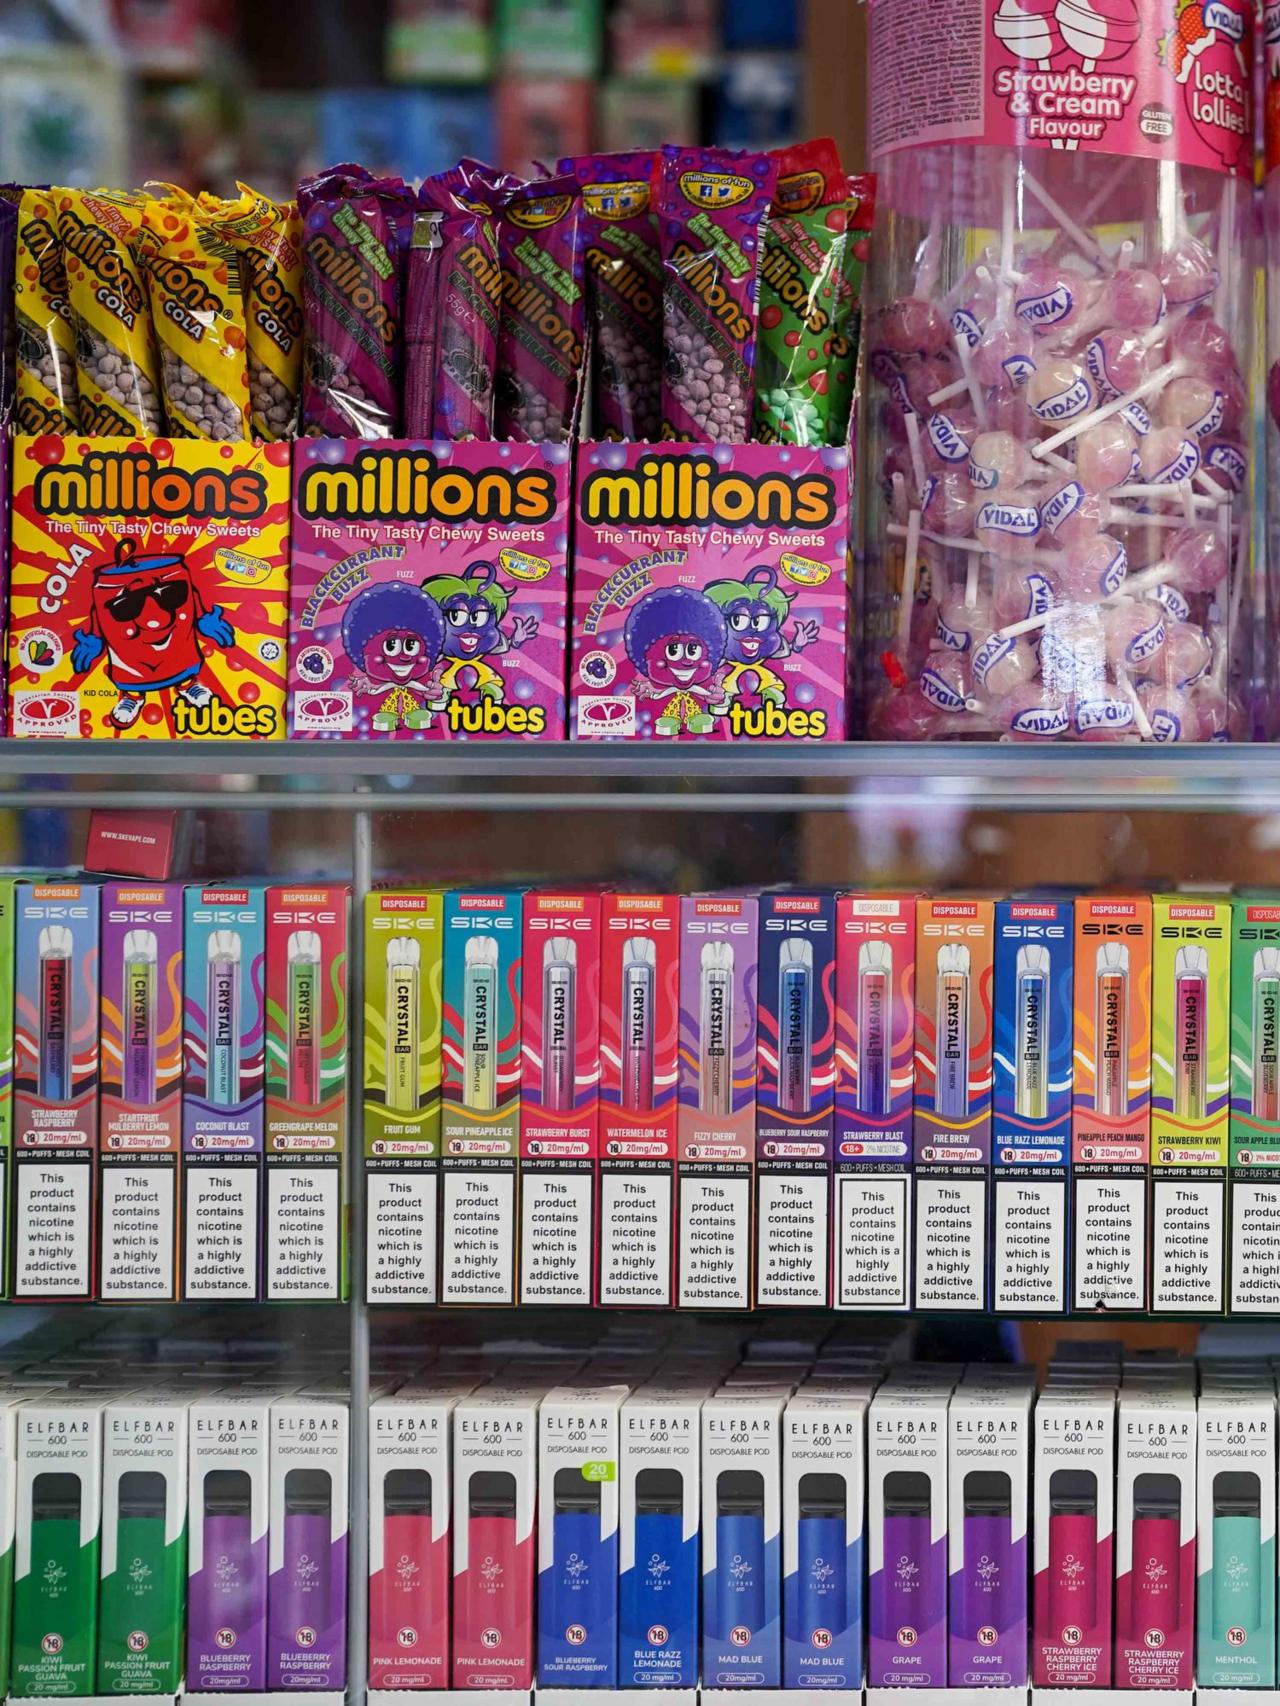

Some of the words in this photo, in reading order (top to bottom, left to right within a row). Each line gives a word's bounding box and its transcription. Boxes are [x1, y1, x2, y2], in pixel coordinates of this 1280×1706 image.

[997, 68, 1134, 100] Strawberry
[1195, 61, 1243, 100] lotta
[1010, 93, 1029, 114] &
[1038, 93, 1120, 116] Cream
[1142, 110, 1172, 120] GLUTEN
[1193, 92, 1245, 133] lollies
[1029, 119, 1102, 136] Flavour
[1146, 123, 1168, 133] FREE
[683, 174, 720, 183] millions
[734, 178, 751, 188] fun
[58, 211, 147, 313] millions
[307, 236, 397, 343] millions
[97, 288, 135, 329] COLA
[164, 301, 204, 340] COLA
[256, 311, 292, 353] COLA
[39, 456, 262, 515] millions
[304, 455, 550, 518] millions
[587, 461, 830, 522] millions
[984, 509, 1037, 528] VIDAL
[46, 521, 71, 533] The
[77, 521, 105, 536] Tiny
[110, 522, 148, 536] Tasty
[151, 523, 202, 537] Chewy
[206, 524, 261, 537] Sweets
[312, 526, 341, 538] The
[346, 526, 379, 541] Tiny
[384, 526, 424, 542] Tasty
[428, 527, 482, 543] Chewy
[487, 528, 545, 542] Sweets
[595, 531, 623, 543] The
[628, 531, 660, 546] Tiny
[666, 531, 705, 546] Tasty
[710, 531, 763, 547] Chewy
[768, 532, 825, 546] Sweets
[40, 543, 92, 614] COLA
[301, 545, 406, 628] BLACKCURRANT
[330, 568, 370, 603] BUZZ
[613, 572, 652, 609] BUZZ
[584, 550, 687, 634] BLACKCURRANT
[16, 713, 77, 727] APPROVED
[173, 697, 276, 733] tubes
[449, 698, 545, 731] tubes
[730, 702, 826, 735] tubes
[1016, 709, 1069, 731] VIDAL
[382, 899, 426, 909] DISPOSABLE
[1170, 908, 1214, 918] DISPOSABLE
[396, 986, 408, 1044] CRYSTAL
[1185, 996, 1197, 1053] CRYSTAL
[195, 1122, 222, 1131] COCONUT
[223, 1122, 249, 1131] BLAST
[384, 1125, 404, 1134] FRUIT
[405, 1125, 421, 1134] GUM
[446, 1127, 463, 1136] SOUR
[464, 1127, 499, 1136] PINEAPPLE
[500, 1127, 512, 1136] ICE
[526, 1128, 568, 1137] STRAWBERRY
[569, 1128, 590, 1137] BURST
[607, 1128, 654, 1138] WATERMELON
[656, 1129, 668, 1138] ICE
[843, 1131, 883, 1140] STRAWBERRY
[884, 1131, 903, 1140] BLAST
[933, 1134, 948, 1143] FIRE
[949, 1134, 970, 1143] BREW
[997, 1135, 1015, 1145] BLUE
[1015, 1136, 1030, 1145] RAZZ
[1031, 1136, 1065, 1145] LEMONADE
[1158, 1136, 1203, 1145] STRAWBERRY
[1205, 1136, 1221, 1145] KIWI
[392, 1143, 430, 1152] 20mg/ml
[389, 1183, 412, 1193] This
[379, 1198, 422, 1209] product
[377, 1212, 424, 1222] contains
[378, 1227, 422, 1236] nicotine
[377, 1241, 407, 1250] which
[413, 1241, 422, 1250] is
[386, 1256, 421, 1267] highly
[375, 1270, 425, 1280] addictive
[371, 1285, 432, 1295] substance.
[634, 1651, 657, 1659] BLUE
[1042, 1647, 1102, 1655] STRAWBERRY
[200, 1655, 251, 1663] BLUEBERRY
[392, 1657, 442, 1665] LEMONADE
[633, 1660, 682, 1668] LEMONADE
[892, 1656, 922, 1664] GRAPE
[1046, 1655, 1097, 1663] RASPBERRY
[1215, 1656, 1257, 1664] MENTHOL
[200, 1663, 251, 1671] RASPBERRY
[1046, 1663, 1081, 1671] CHERRY
[1083, 1663, 1097, 1671] ICE
